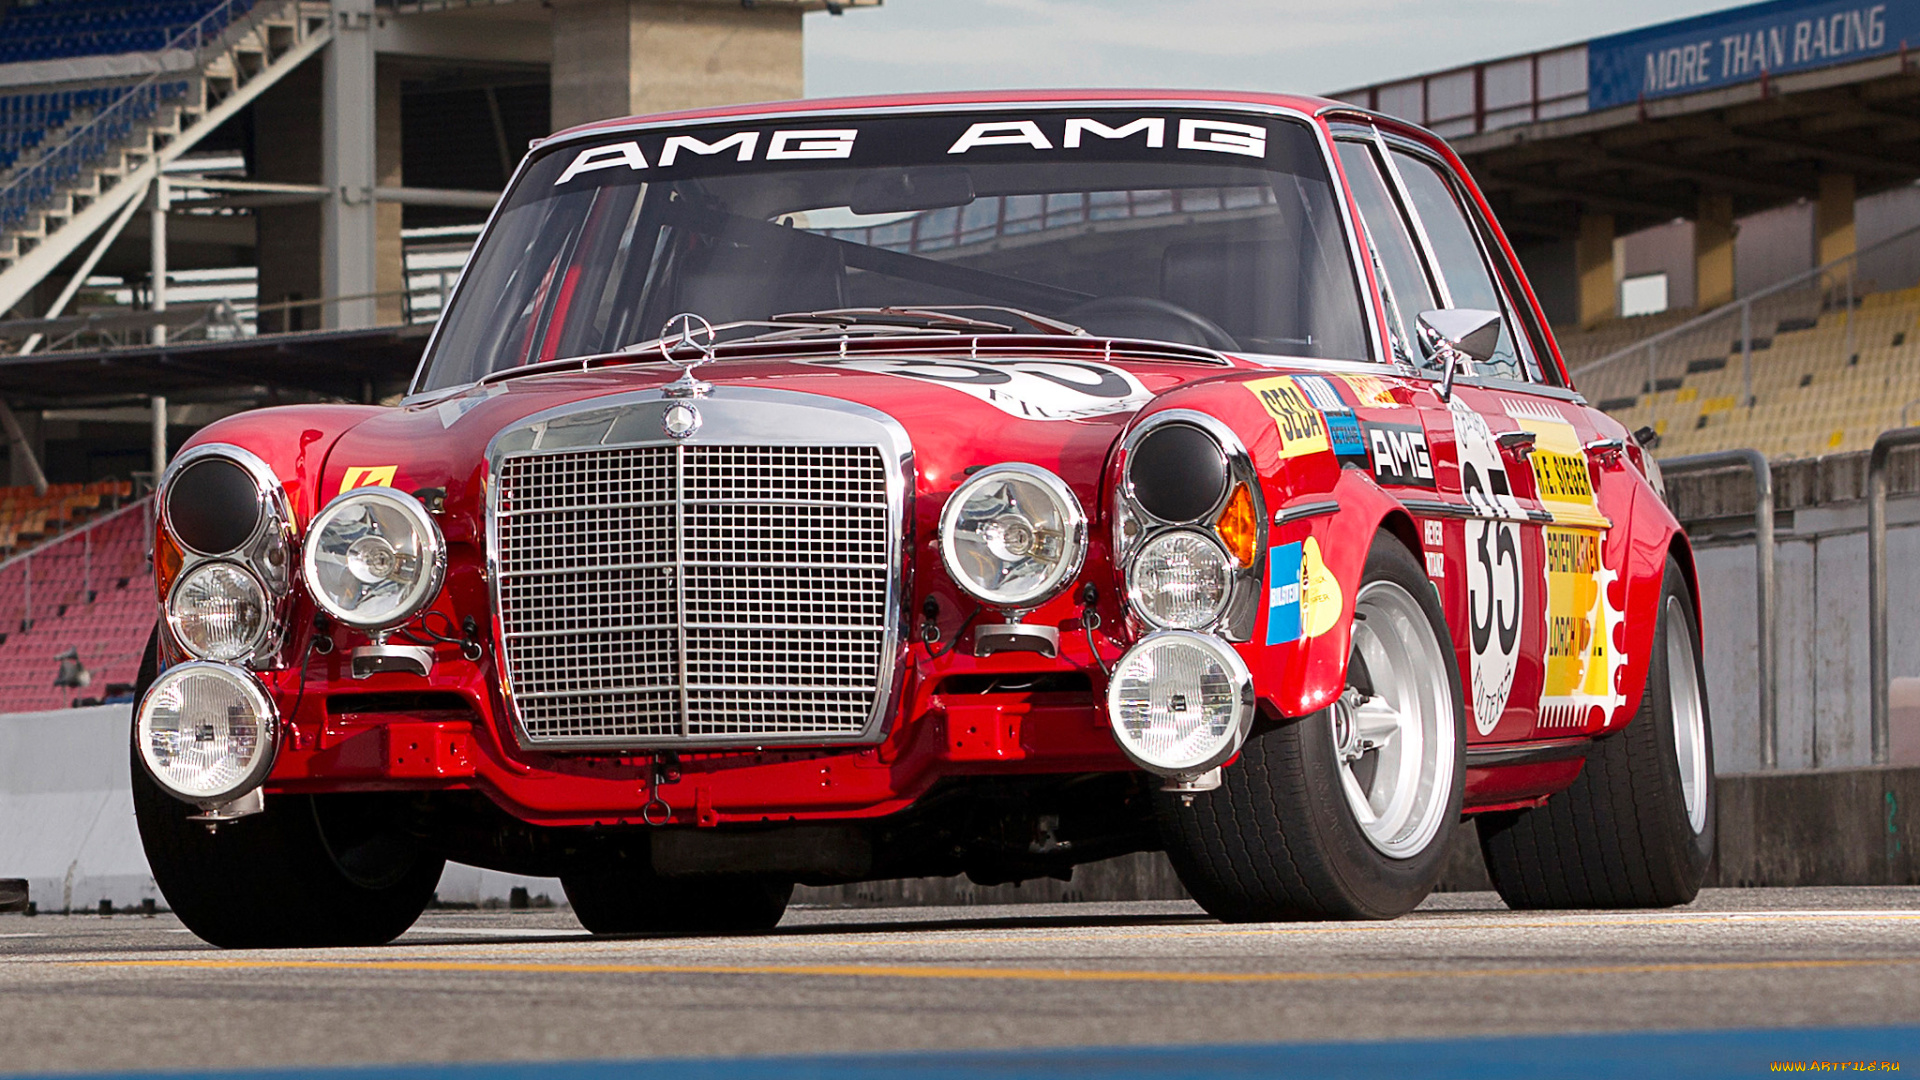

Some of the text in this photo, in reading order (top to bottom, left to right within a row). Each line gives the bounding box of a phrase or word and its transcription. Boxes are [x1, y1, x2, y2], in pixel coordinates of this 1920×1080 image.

[1643, 5, 1886, 92] MORE THAN RACING
[555, 117, 1267, 186] AMG AMG
[1369, 429, 1434, 479] AMG
[1463, 460, 1520, 656] 35
